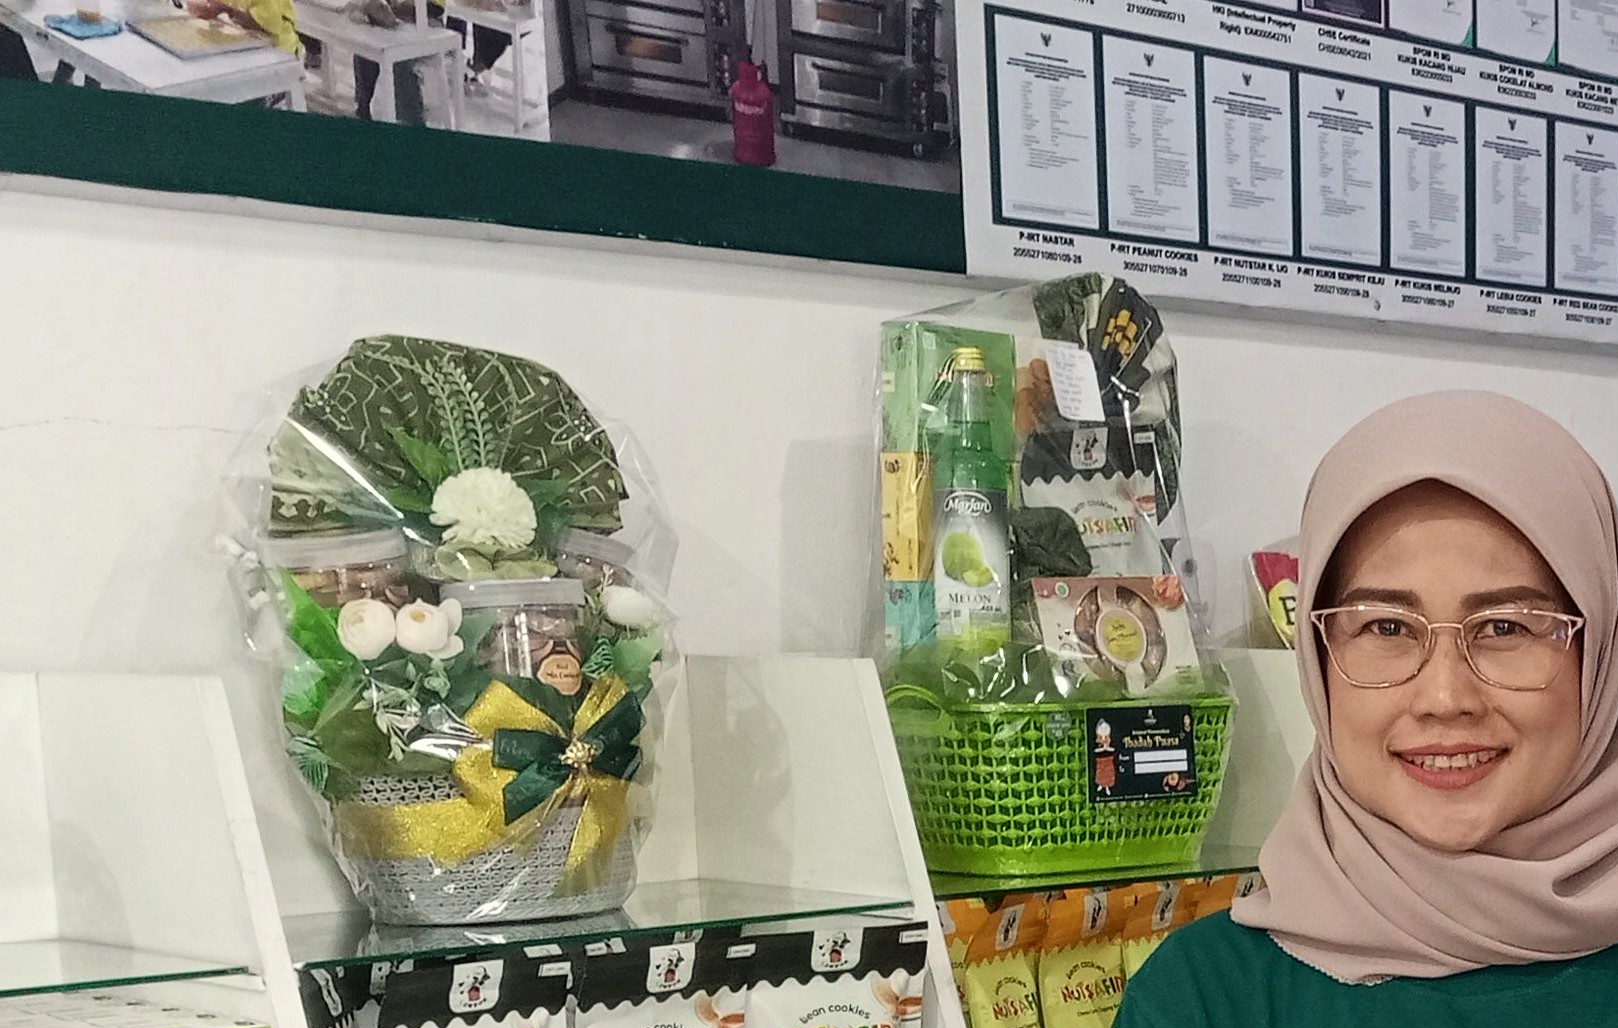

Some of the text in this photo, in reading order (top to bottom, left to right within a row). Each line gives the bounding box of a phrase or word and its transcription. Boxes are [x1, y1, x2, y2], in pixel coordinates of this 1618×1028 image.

[1042, 234, 1075, 248] NASTAR
[1131, 245, 1164, 259] PEANUT
[1164, 250, 1199, 263] COOKIES
[948, 592, 991, 605] MELON
[800, 1002, 872, 1025] bean cookies
[992, 990, 1038, 1022] NUTSAFI
